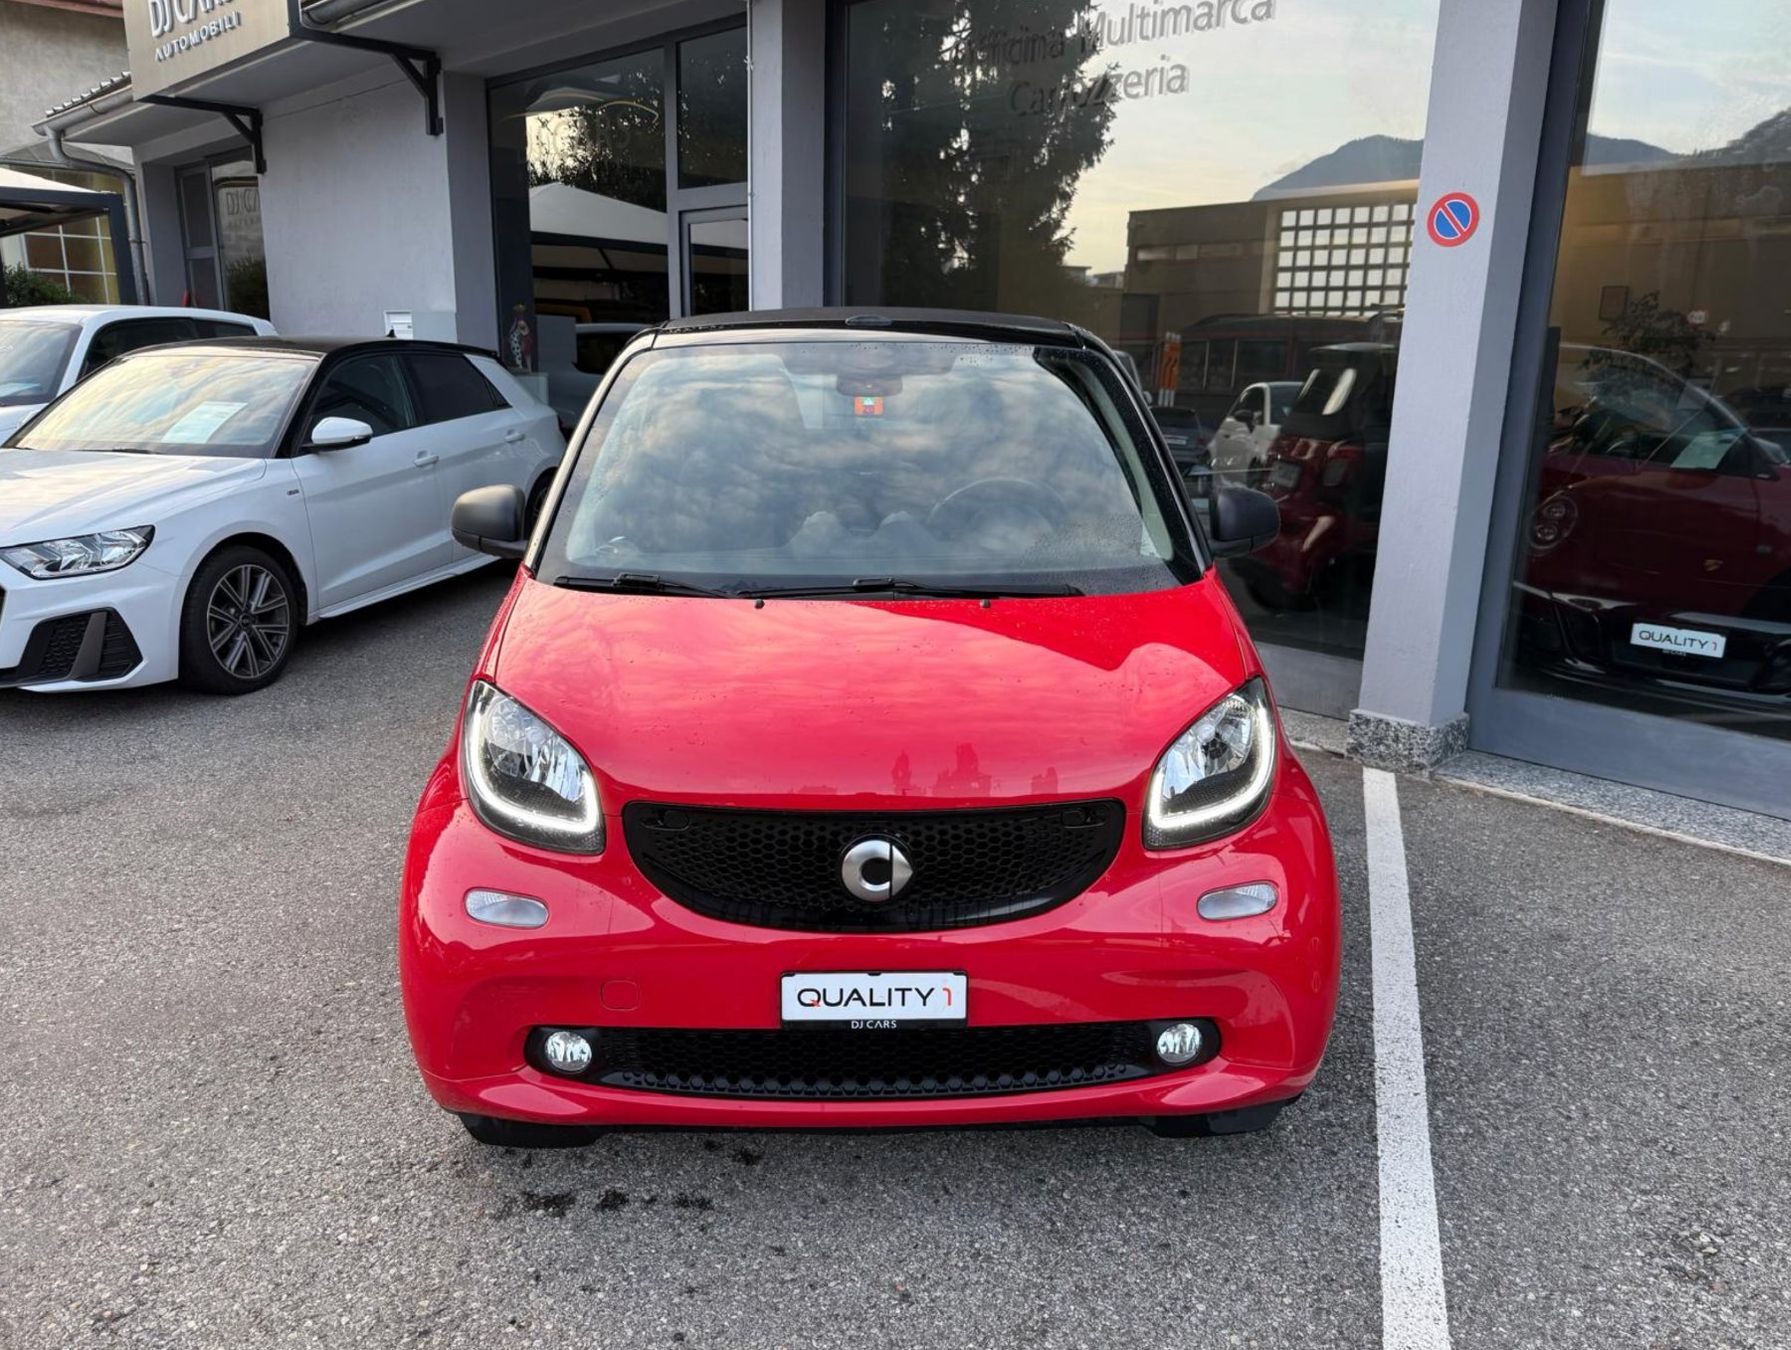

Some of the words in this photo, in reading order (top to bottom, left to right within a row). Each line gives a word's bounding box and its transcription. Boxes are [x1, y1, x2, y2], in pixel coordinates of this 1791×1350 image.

[154, 11, 242, 62] AUTOMOBILI
[1080, 0, 1274, 54] Multimarca
[1638, 630, 1709, 649] QUALITY
[797, 987, 935, 1008] QUALITY
[942, 987, 952, 1007] 1
[851, 1020, 864, 1030] DJ
[866, 1020, 897, 1030] CARS
